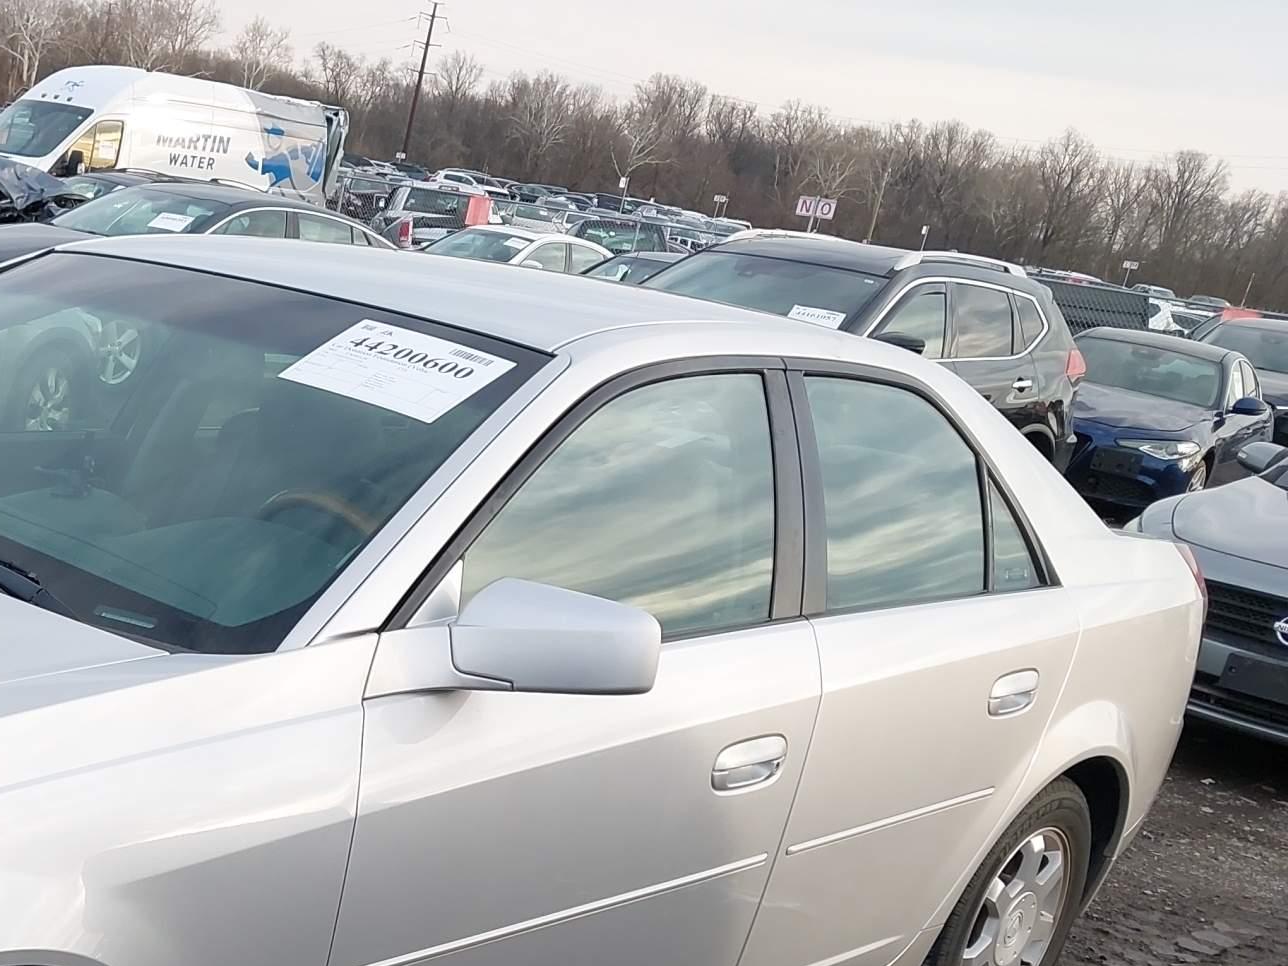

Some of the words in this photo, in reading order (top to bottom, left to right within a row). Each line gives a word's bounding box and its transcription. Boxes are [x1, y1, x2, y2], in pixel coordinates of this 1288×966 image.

[157, 135, 230, 154] MARTIN
[170, 152, 215, 170] WATER
[349, 336, 475, 380] 44200600
